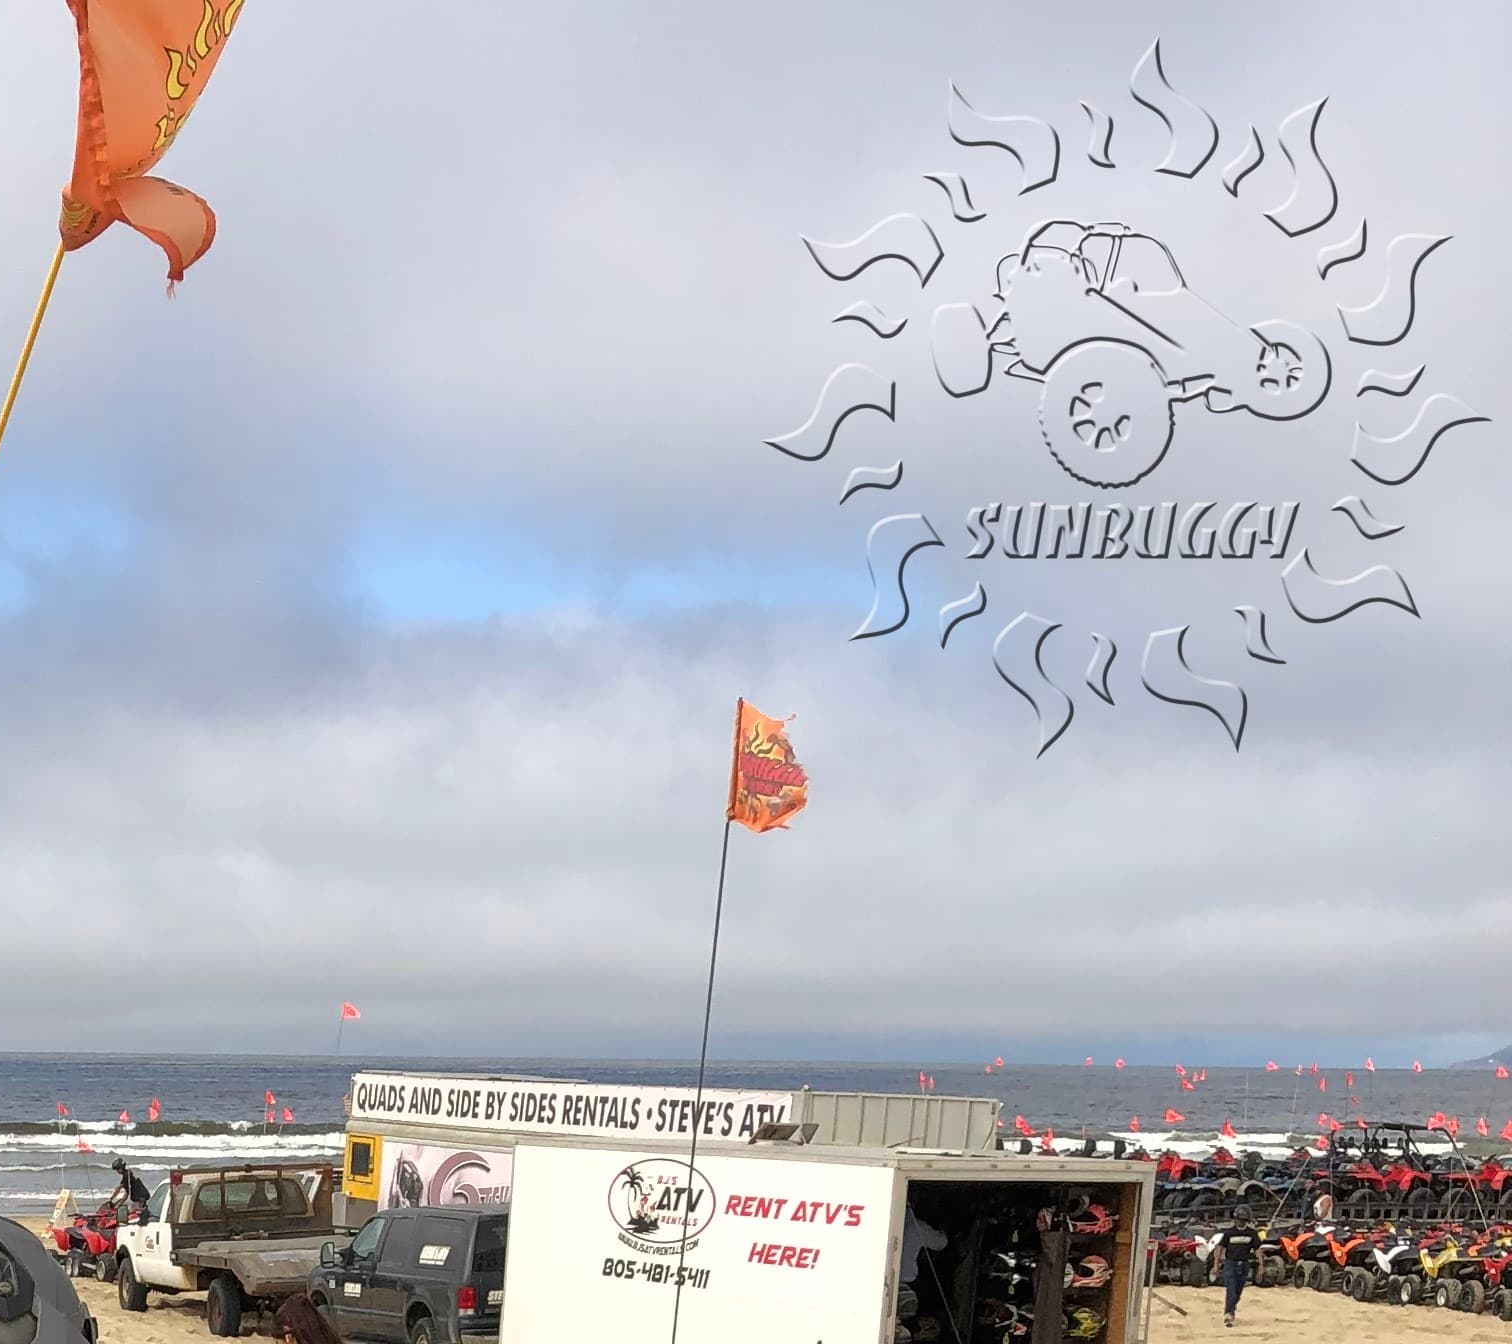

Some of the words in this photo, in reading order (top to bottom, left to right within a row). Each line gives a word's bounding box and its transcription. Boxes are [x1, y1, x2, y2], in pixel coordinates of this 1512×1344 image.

[357, 1082, 406, 1113] QUADS
[408, 1086, 442, 1116] AND
[446, 1088, 481, 1119] SIDE
[485, 1090, 507, 1121] BY
[508, 1091, 557, 1125] SIDES
[561, 1094, 641, 1131] RENTALS
[655, 1098, 734, 1137] STEVE'S
[656, 1186, 705, 1213] ATV
[724, 1194, 789, 1220] RENT
[790, 1200, 865, 1227] ATV'S
[747, 1242, 821, 1270] HERE!
[602, 1258, 711, 1290] 805-481-5411
